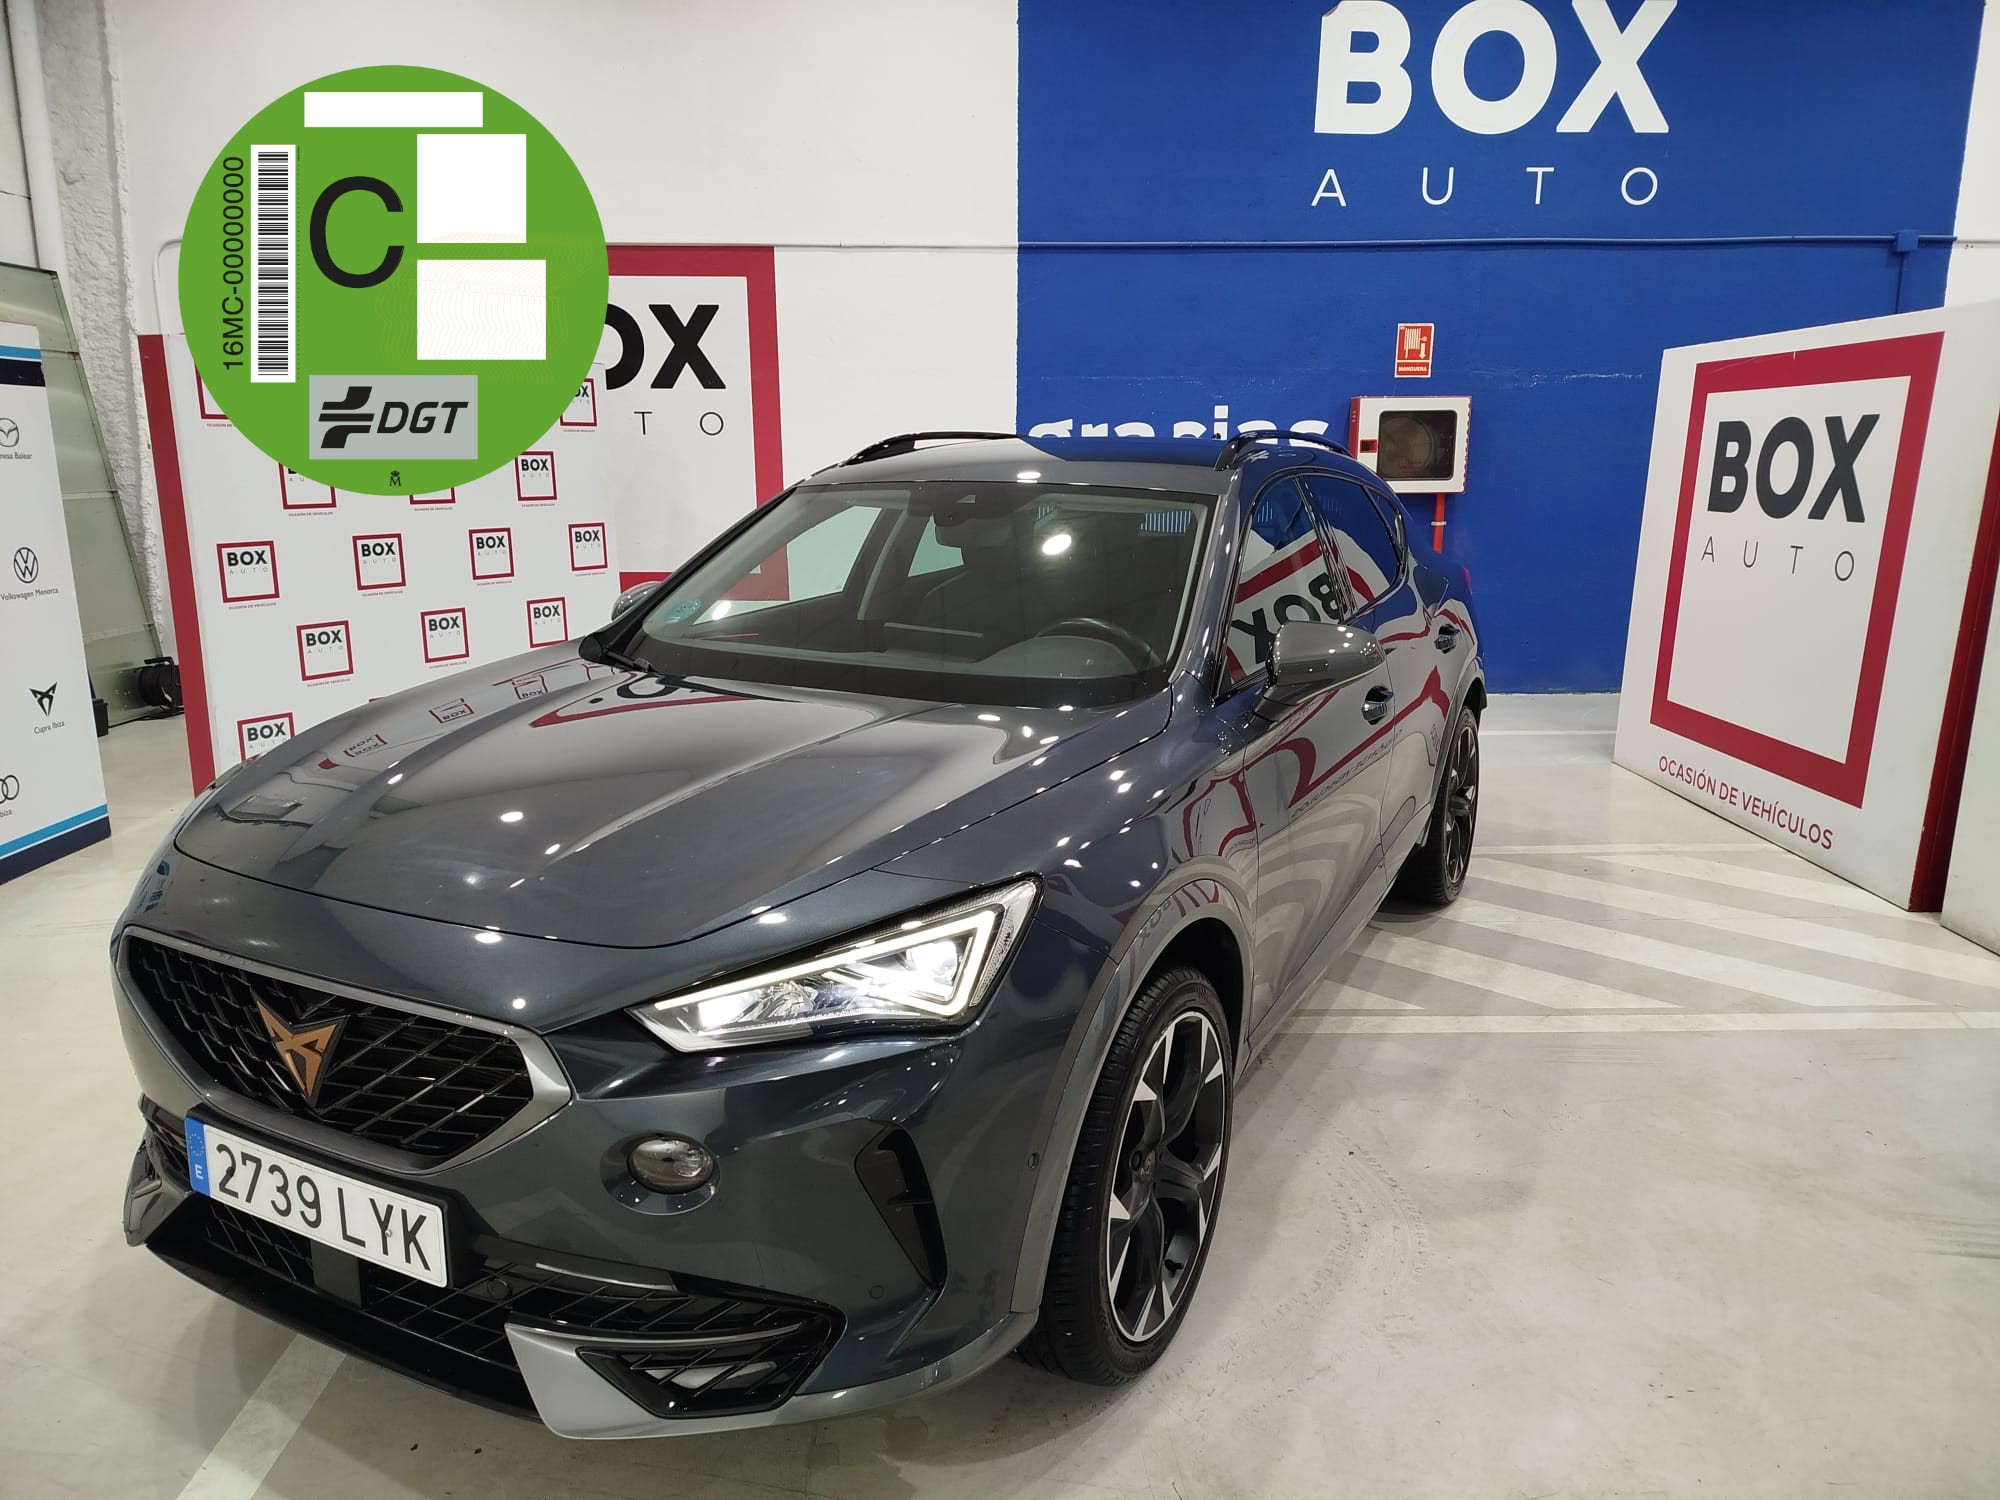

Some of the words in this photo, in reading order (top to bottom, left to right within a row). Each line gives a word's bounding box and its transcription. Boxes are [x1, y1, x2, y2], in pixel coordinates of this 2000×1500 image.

[1314, 0, 1678, 135] BOX
[1311, 167, 1658, 207] AUTO
[521, 458, 549, 471] BOX
[1707, 414, 1880, 523] BOX
[476, 535, 506, 550] BOX
[575, 529, 600, 543] BOX
[361, 541, 396, 557] BOX
[227, 550, 268, 567] BOX
[1701, 536, 1855, 581] AUTO
[0, 591, 34, 601] Volkswagen
[35, 588, 59, 597] Menorca
[533, 604, 561, 619] BOX
[428, 615, 460, 631] BOX
[305, 629, 343, 647] BOX
[33, 725, 52, 735] Cupra
[52, 720, 65, 729] Ibiza
[246, 721, 286, 742] BOX
[1659, 756, 1717, 796] OCASIÓN
[1719, 782, 1738, 806] DE
[1742, 791, 1833, 850] VEHÍCULOS
[0, 809, 12, 818] biza
[195, 1163, 204, 1180] E
[216, 1143, 322, 1229] 2739
[337, 1186, 431, 1271] LYK
